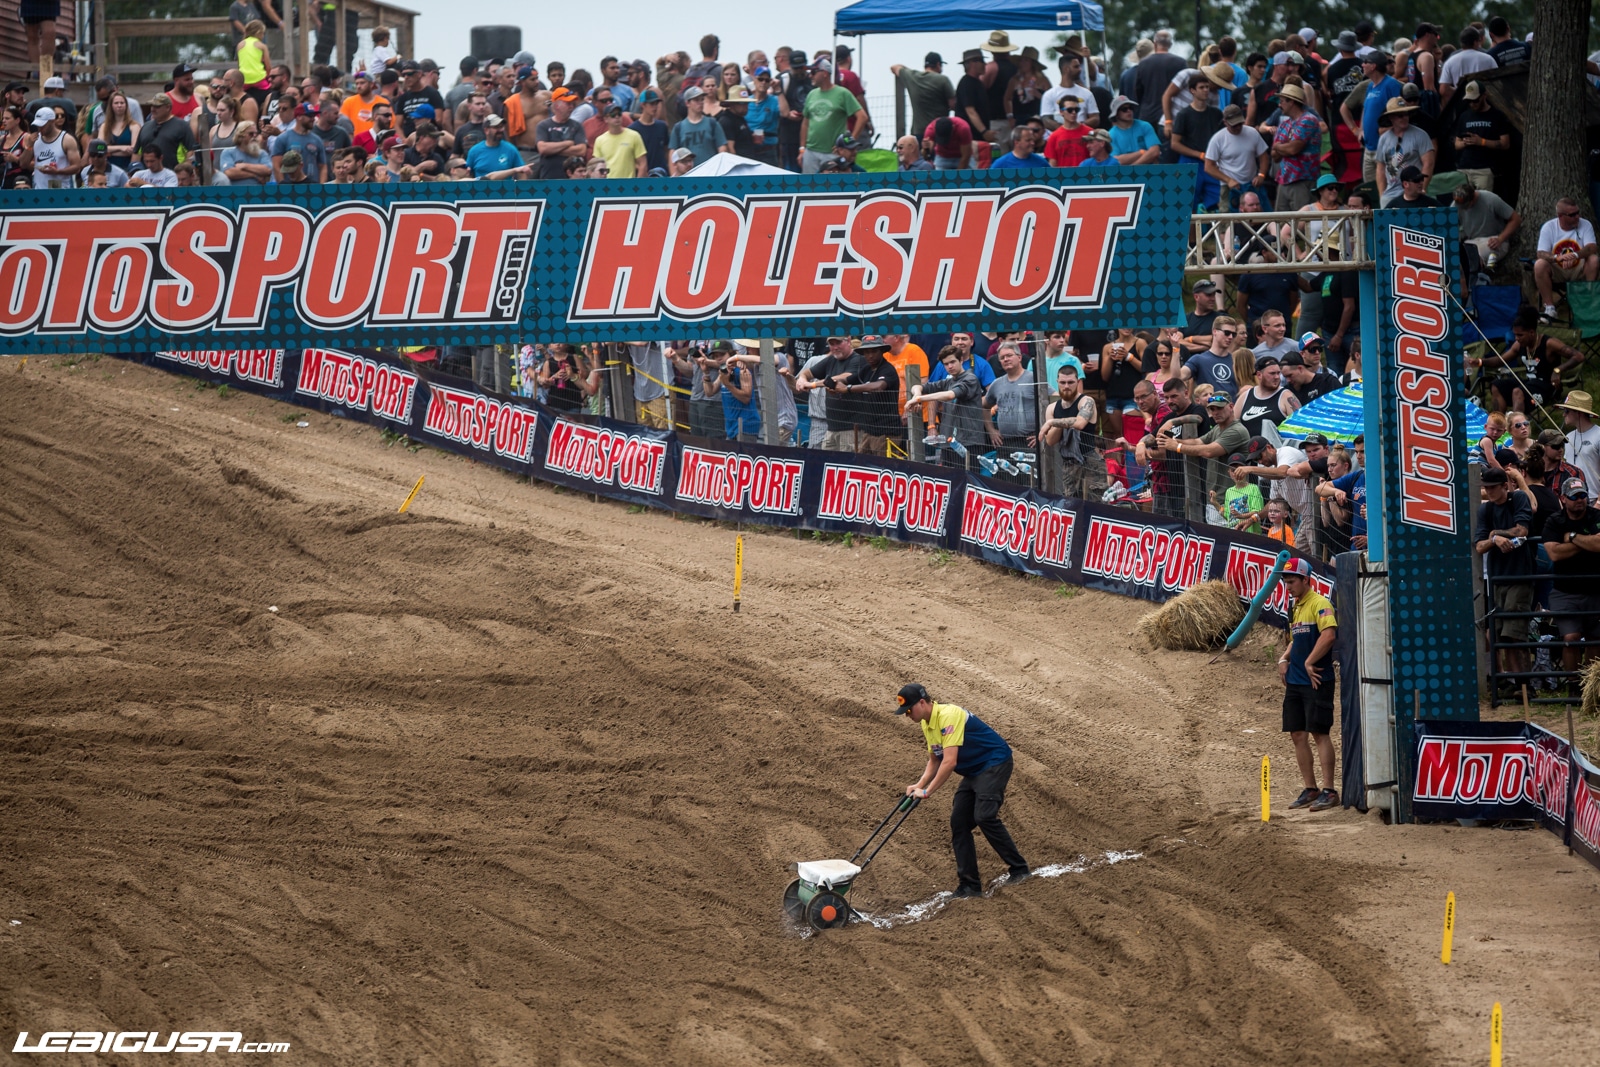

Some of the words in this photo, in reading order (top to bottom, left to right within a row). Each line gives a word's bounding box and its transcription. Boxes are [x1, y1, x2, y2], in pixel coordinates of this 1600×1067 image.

[684, 130, 706, 146] FLY
[0, 201, 543, 334] OTOSPORT
[569, 185, 1143, 322] HOLESHOT
[296, 348, 417, 424] MOTOSPORT
[1390, 226, 1454, 532] MOTOSPORT
[423, 382, 538, 463] MOTOSPORT
[545, 417, 667, 495] MOTOSPORT
[676, 445, 804, 516] MOTOSPORT
[817, 463, 951, 536] MOTOSPORT
[960, 484, 1076, 569] MOTOSPORT
[1081, 515, 1215, 593] MOTOSPORT
[1413, 735, 1570, 826] MOTOSPORT
